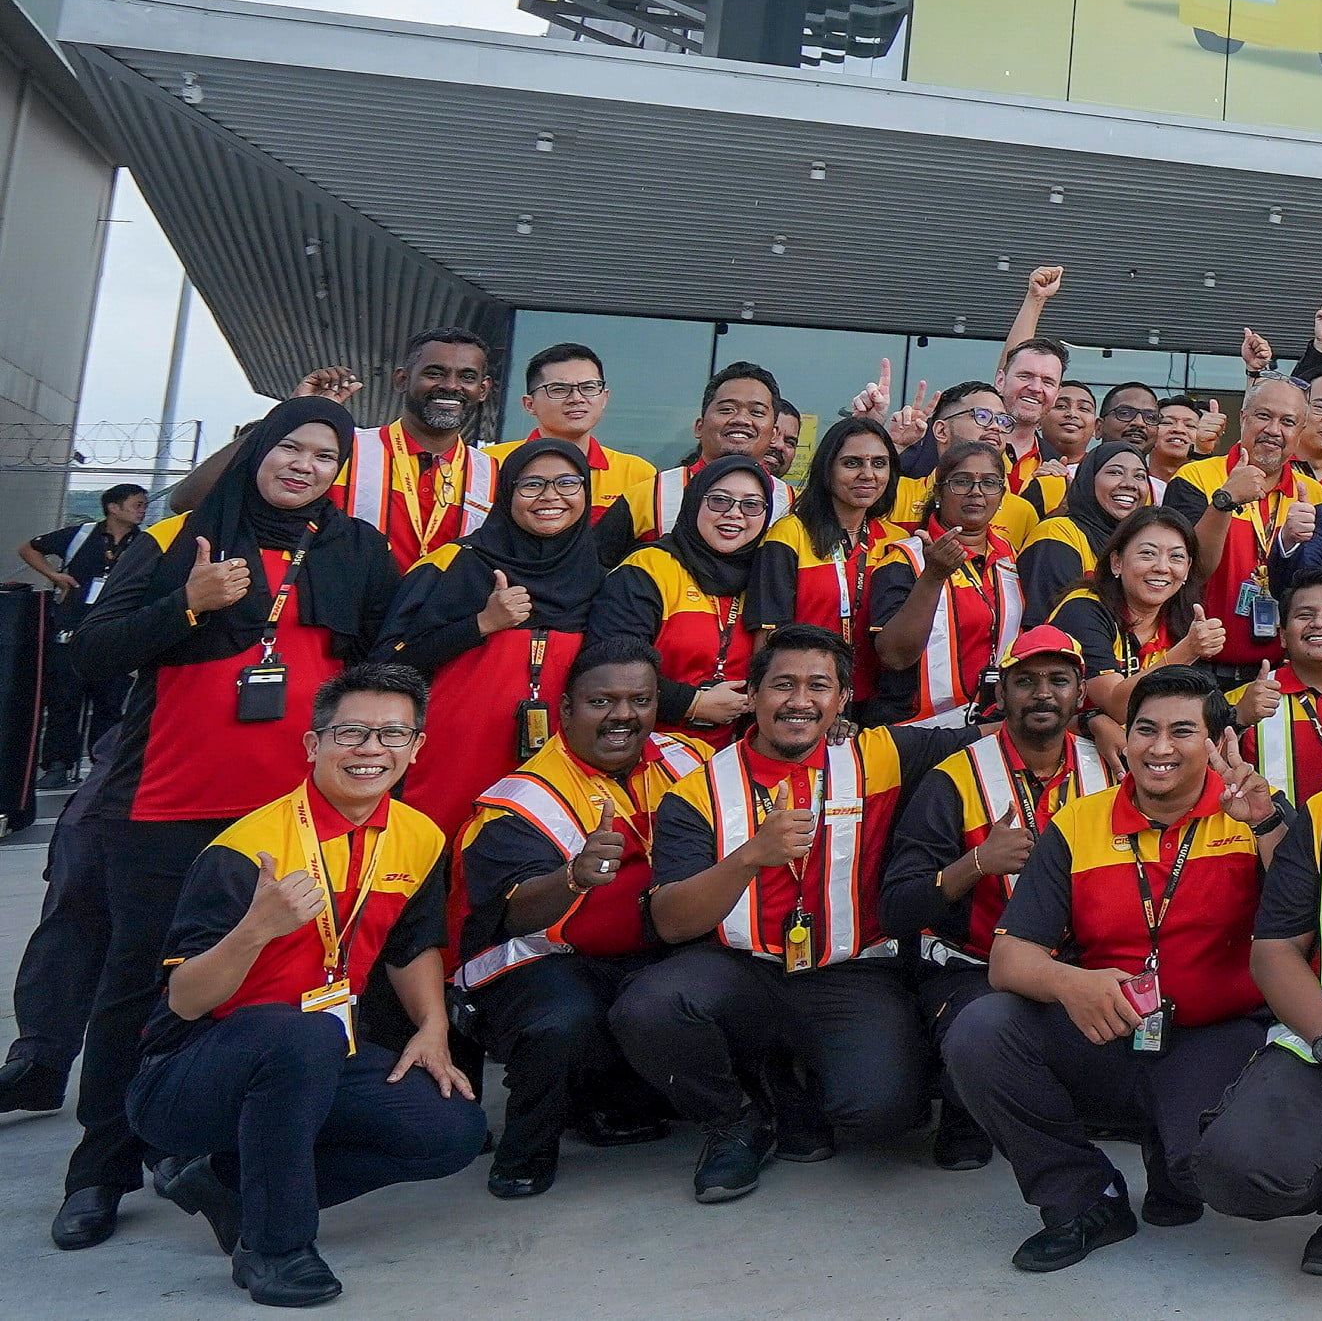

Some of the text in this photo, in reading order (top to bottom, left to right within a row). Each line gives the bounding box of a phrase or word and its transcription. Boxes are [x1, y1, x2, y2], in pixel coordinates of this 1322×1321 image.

[299, 800, 309, 827] DHL
[1208, 834, 1248, 848] DHL
[312, 853, 322, 883] DHL
[381, 872, 415, 883] DHL
[322, 911, 332, 942] DHL
